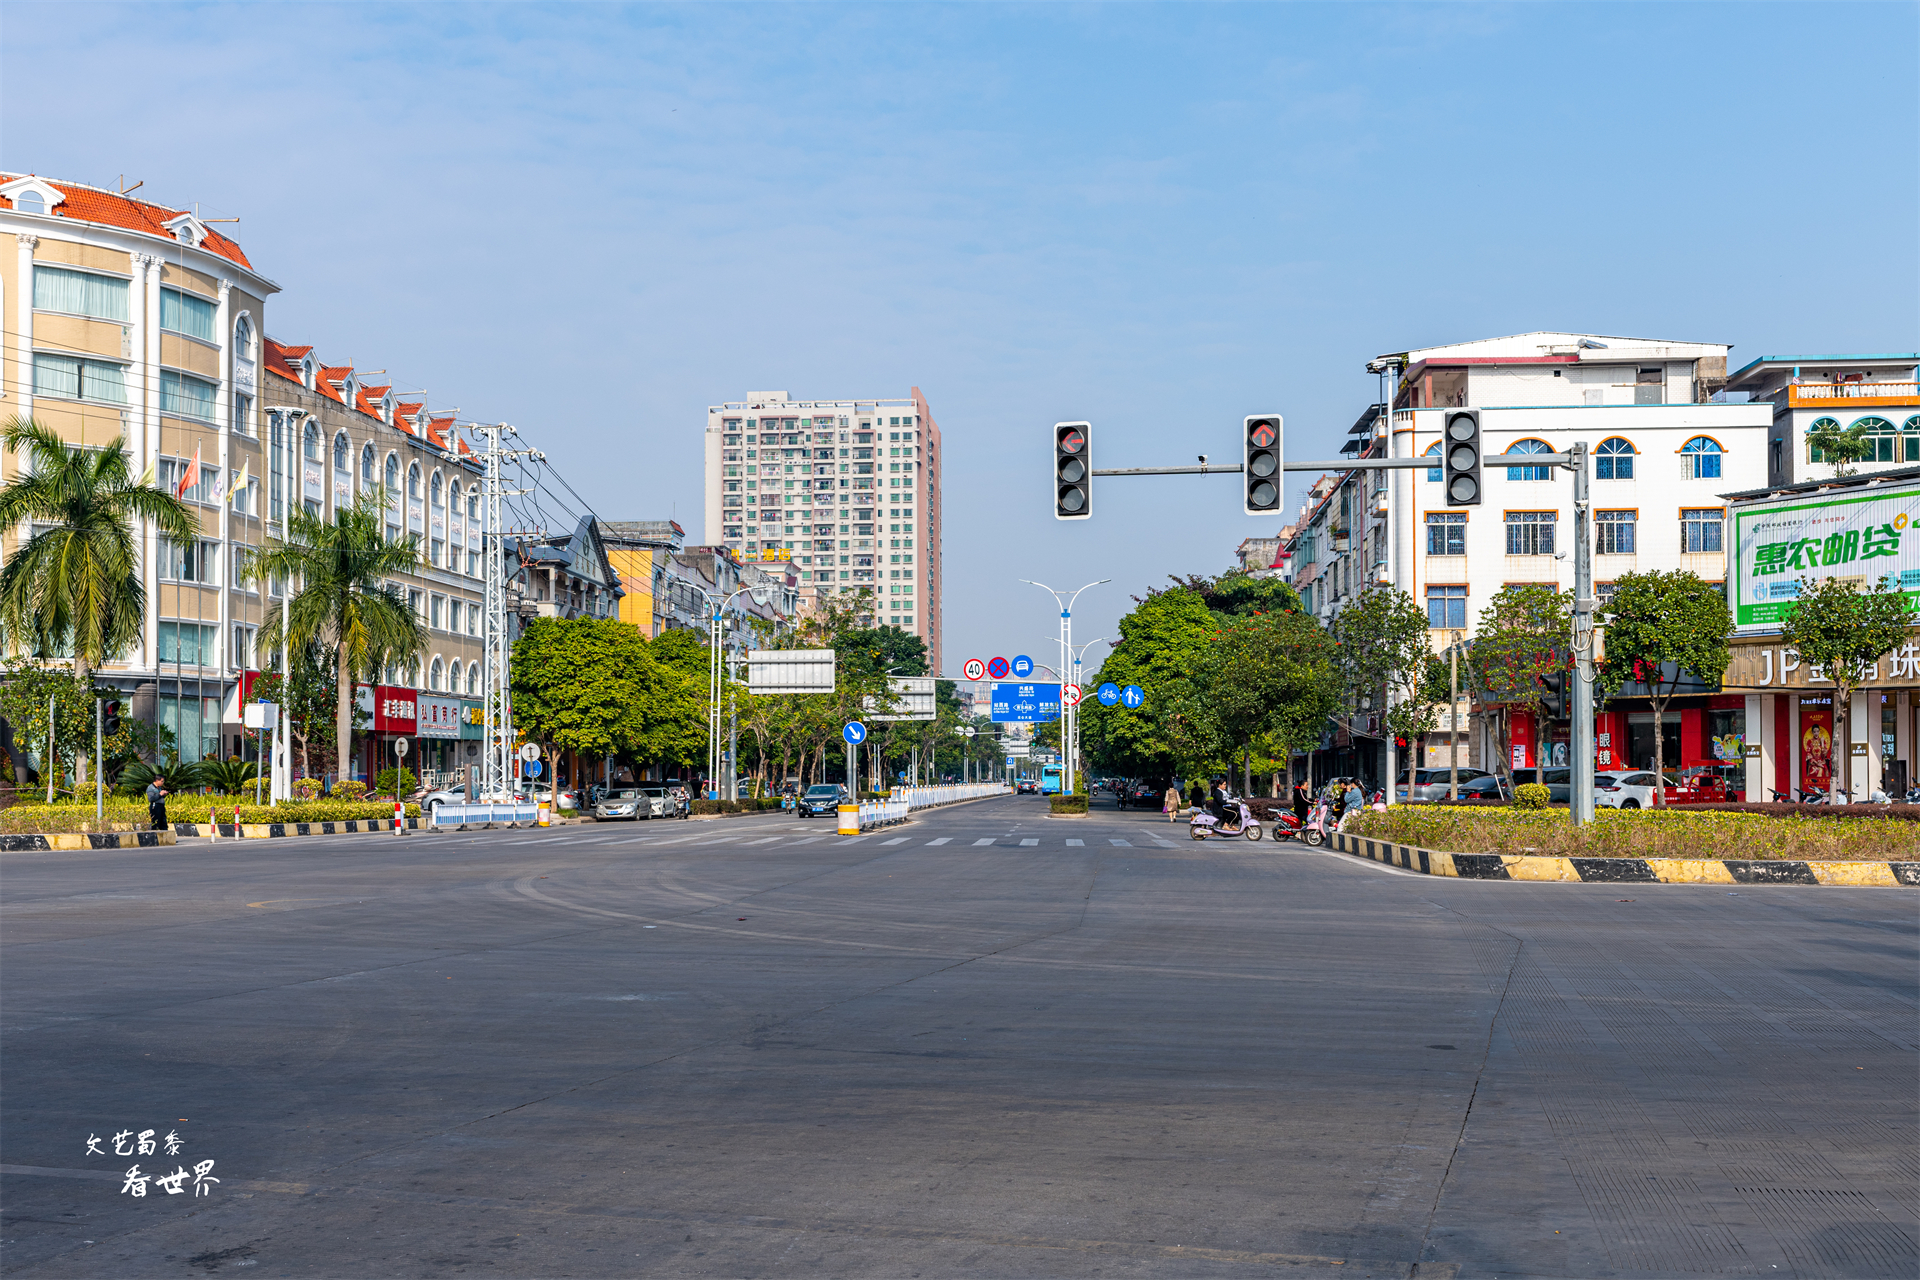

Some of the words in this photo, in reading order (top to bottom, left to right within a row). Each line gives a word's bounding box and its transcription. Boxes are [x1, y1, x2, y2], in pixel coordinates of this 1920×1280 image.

[763, 548, 790, 560] 酒店
[1752, 524, 1901, 577] 惠农邮贷
[968, 663, 980, 675] 40
[1759, 649, 1801, 685] JP
[1599, 732, 1611, 765] 眼镜
